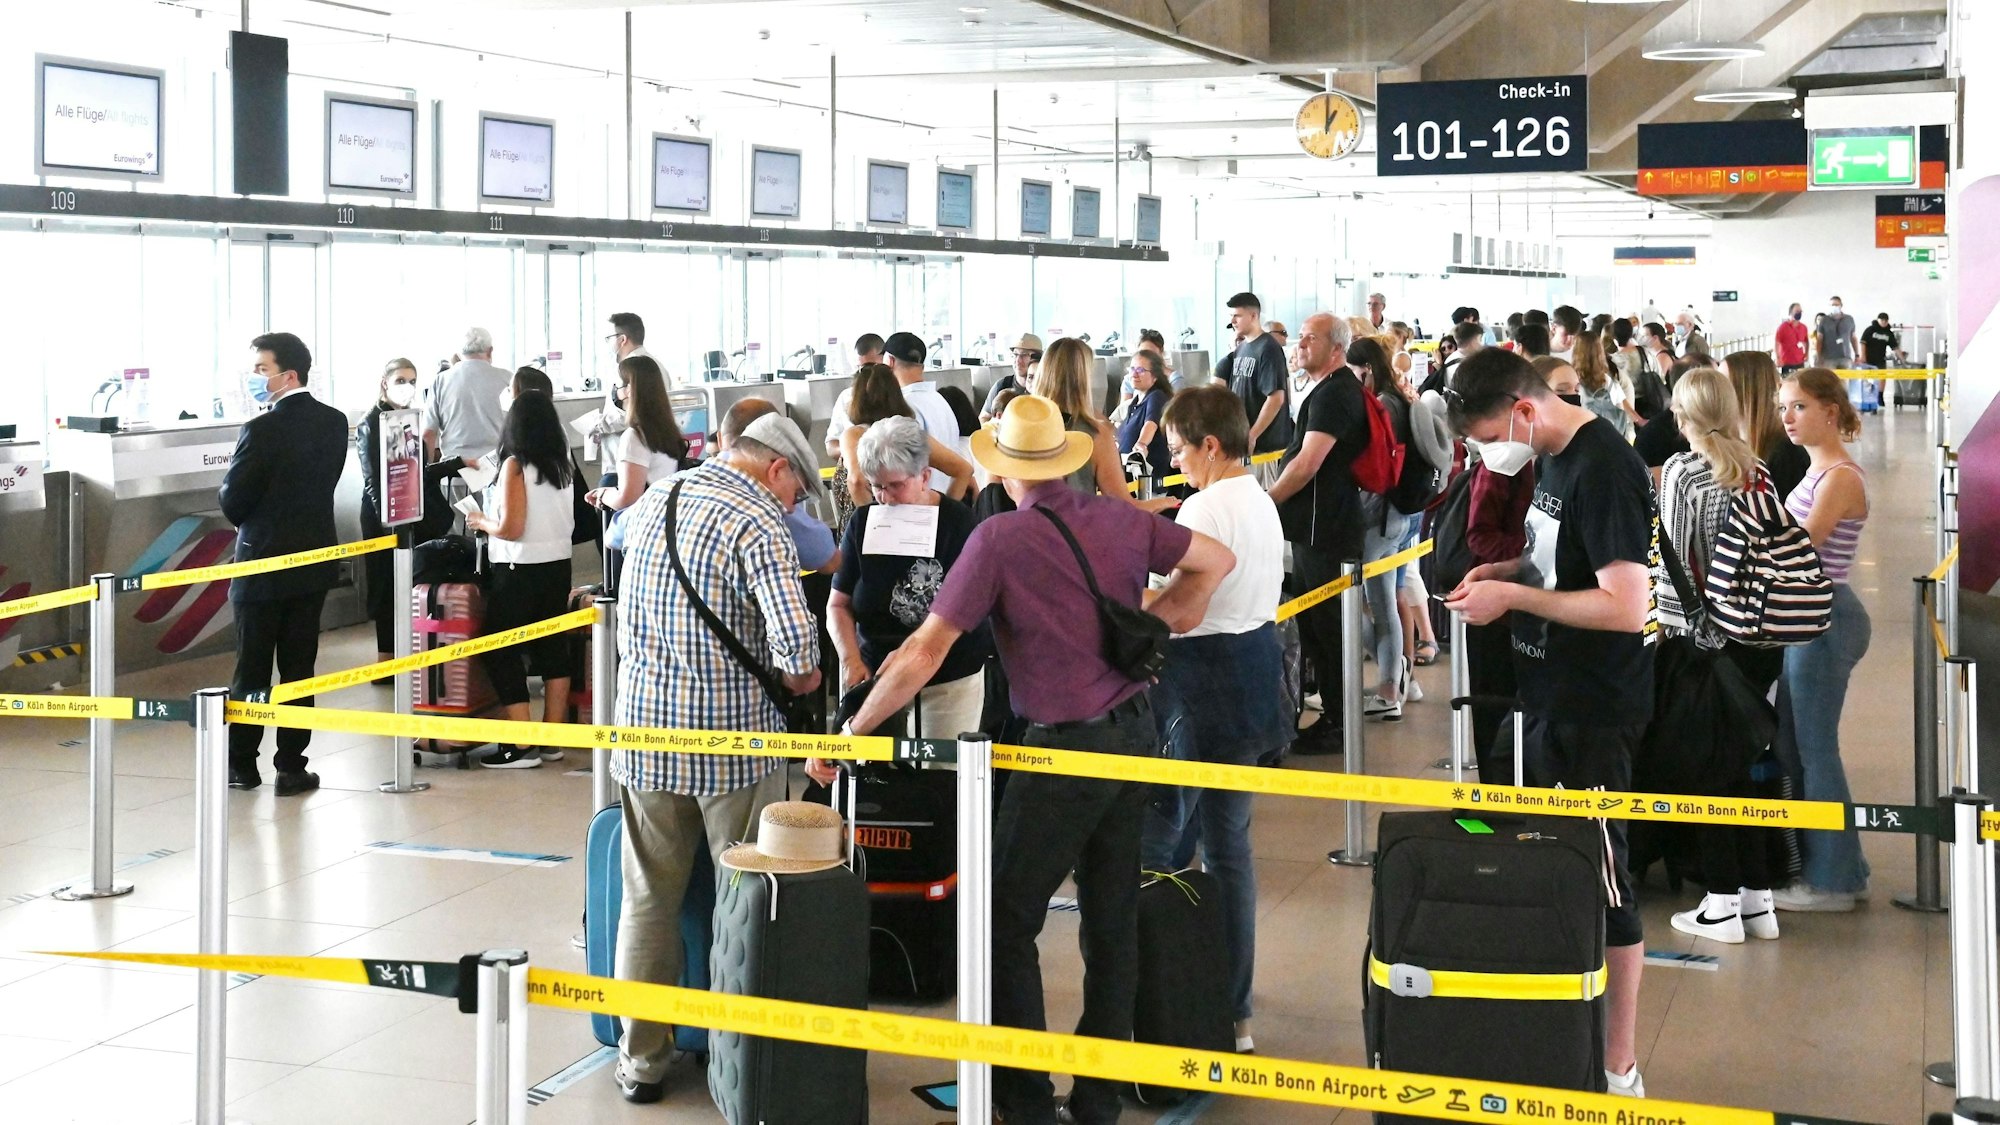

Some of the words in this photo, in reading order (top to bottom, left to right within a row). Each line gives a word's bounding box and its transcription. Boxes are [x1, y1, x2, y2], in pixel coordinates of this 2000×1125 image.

[1499, 82, 1571, 100] Check-in
[55, 104, 74, 118] Alle
[337, 133, 352, 146] Alle
[1392, 116, 1570, 161] 101-126
[113, 153, 146, 165] Eurowings
[1729, 173, 1740, 184] S
[51, 191, 76, 211] 109
[337, 208, 354, 225] 110
[489, 216, 503, 231] 111
[662, 224, 673, 238] 112
[203, 452, 234, 465] Eurowi
[27, 701, 44, 710] Köln
[47, 702, 66, 710] Bonn
[68, 702, 98, 712] Airport
[245, 708, 275, 720] Airport
[621, 733, 641, 743] Köln
[644, 734, 666, 744] Bonn
[669, 735, 703, 747] Airport
[767, 739, 787, 749] Köln
[791, 740, 813, 751] Bonn
[816, 741, 852, 752] Airport
[1016, 753, 1053, 766] Airport
[1486, 792, 1511, 804] Köln
[1516, 793, 1543, 806] Bonn
[1548, 795, 1591, 810] Airport
[1676, 802, 1702, 815] Köln
[1708, 804, 1737, 817] Bonn
[1742, 805, 1788, 820] Airport
[527, 982, 547, 994] onn
[553, 981, 605, 1003] Airport
[1232, 1066, 1267, 1086] Köln
[1275, 1071, 1315, 1092] Bonn
[1323, 1077, 1388, 1100] Airport
[1516, 1098, 1556, 1119] Köln
[1564, 1104, 1608, 1125] Bonn
